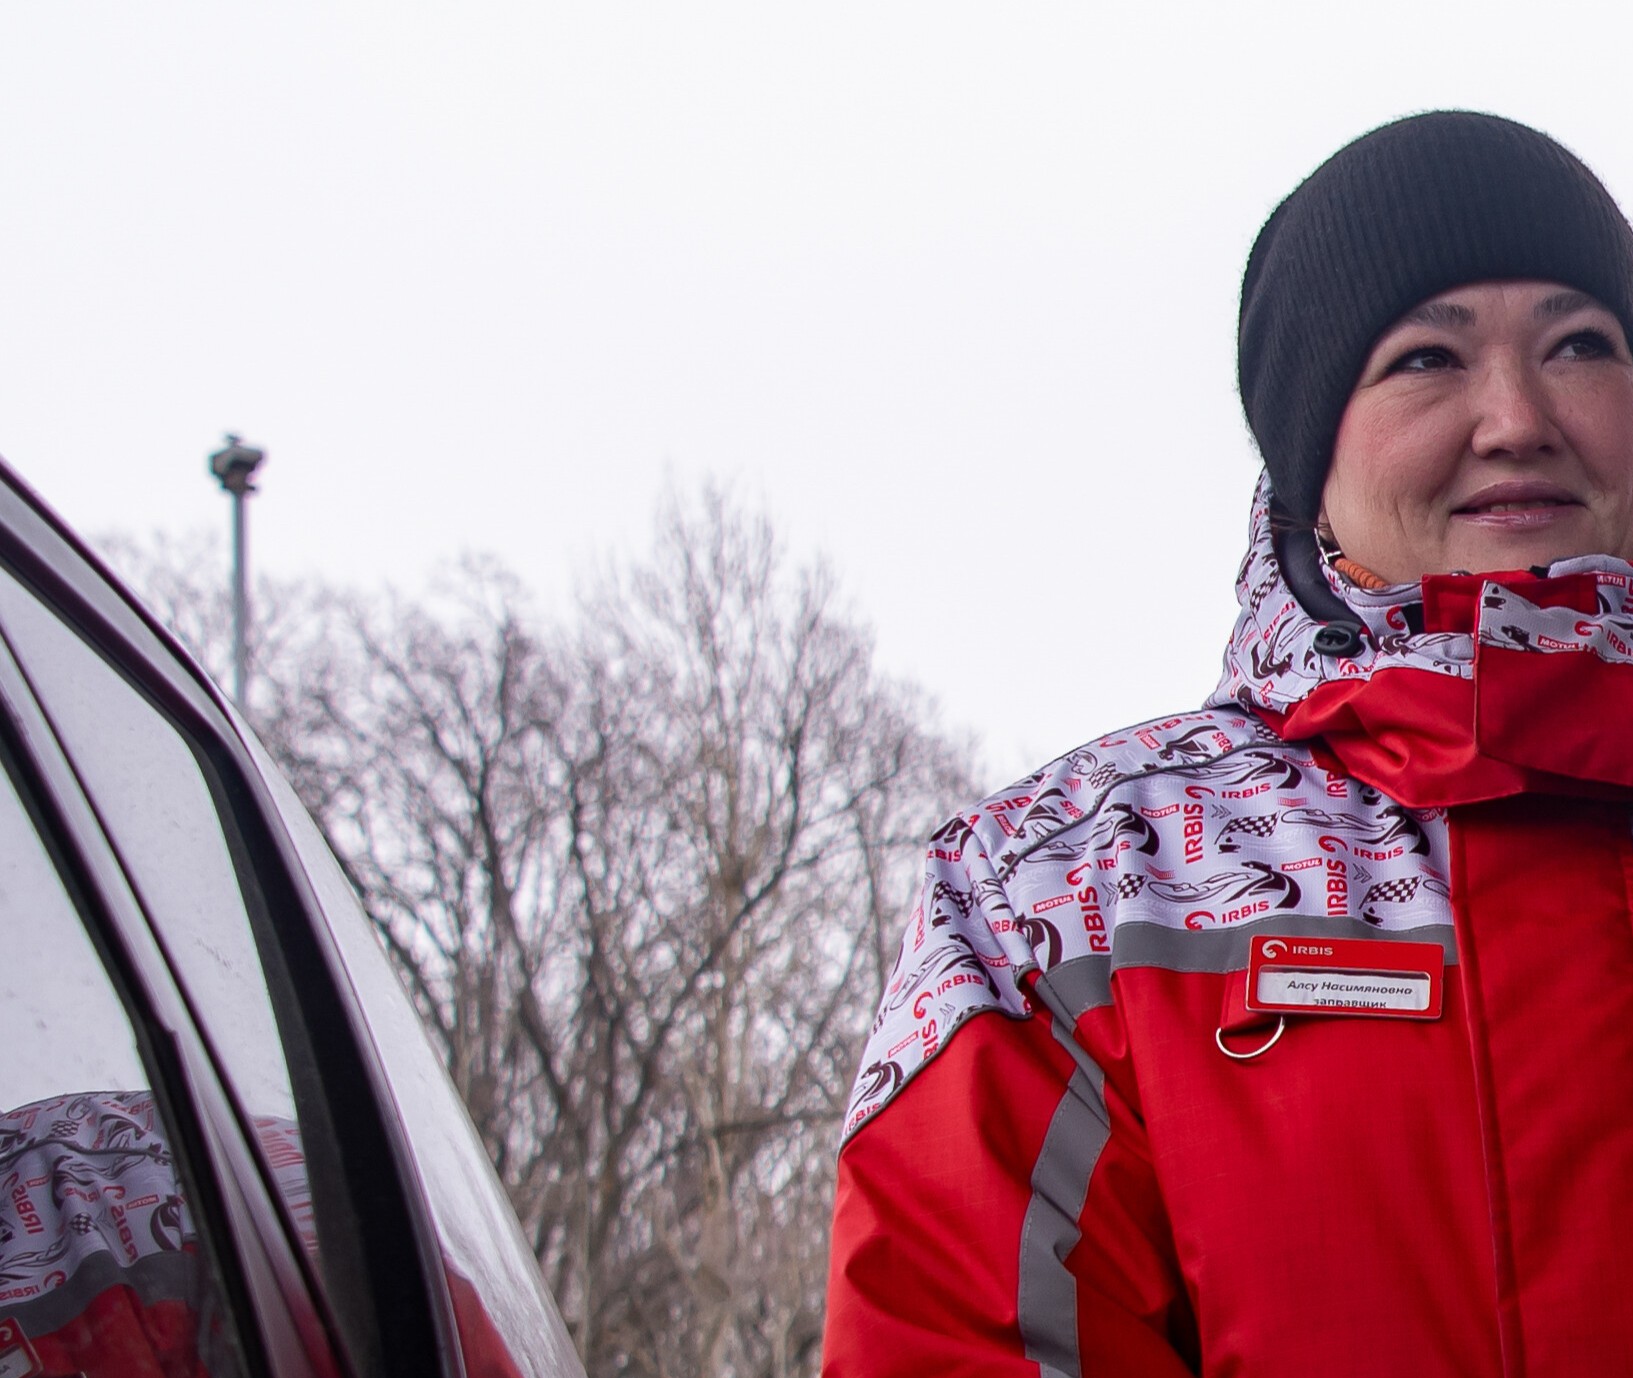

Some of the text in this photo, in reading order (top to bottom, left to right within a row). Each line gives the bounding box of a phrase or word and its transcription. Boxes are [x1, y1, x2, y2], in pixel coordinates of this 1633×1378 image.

[1221, 782, 1272, 800] IRBIS
[1140, 804, 1180, 818] MOTUL
[1184, 803, 1204, 864] IRBIS
[1353, 846, 1404, 862] IRBIS
[1281, 857, 1322, 872] MOTUL
[1327, 858, 1348, 916] IRBIS
[1034, 894, 1074, 914] MOTUL
[1221, 901, 1270, 924] IRBIS
[1293, 945, 1333, 956] IRBIS
[937, 974, 985, 997] IRBIS
[1287, 980, 1413, 995] Алсу Насимяновна
